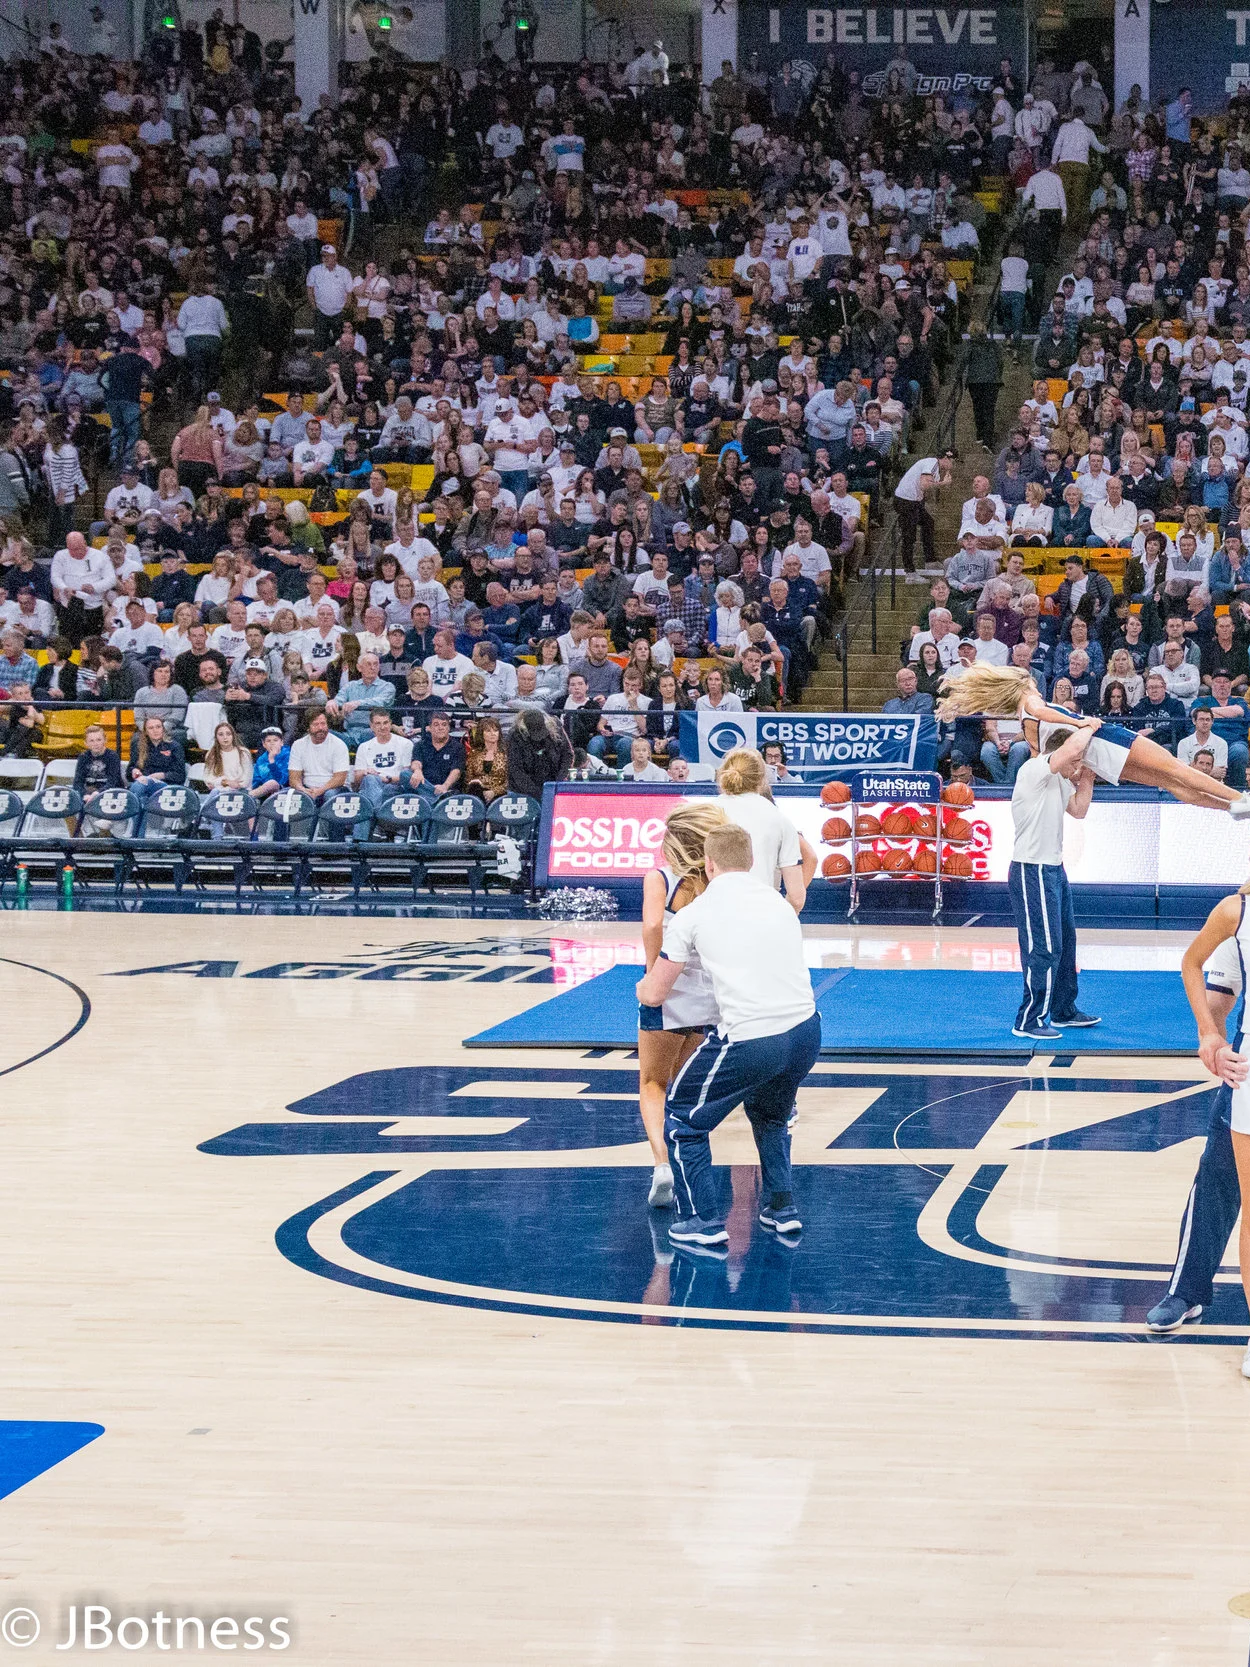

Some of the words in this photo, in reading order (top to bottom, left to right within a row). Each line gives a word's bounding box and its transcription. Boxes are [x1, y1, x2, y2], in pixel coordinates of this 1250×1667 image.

[769, 9, 780, 43] I
[806, 9, 998, 44] BELIEVE
[432, 673, 458, 681] STATE
[761, 722, 809, 742] CBS
[814, 723, 909, 742] SPORTS
[373, 755, 397, 764] STATE
[784, 741, 884, 762] ETWORK
[862, 778, 931, 790] UtahState
[862, 789, 932, 798] BASKETBALL
[552, 816, 669, 849] ossne
[553, 852, 655, 868] FOODS
[97, 959, 560, 984] AGGI
